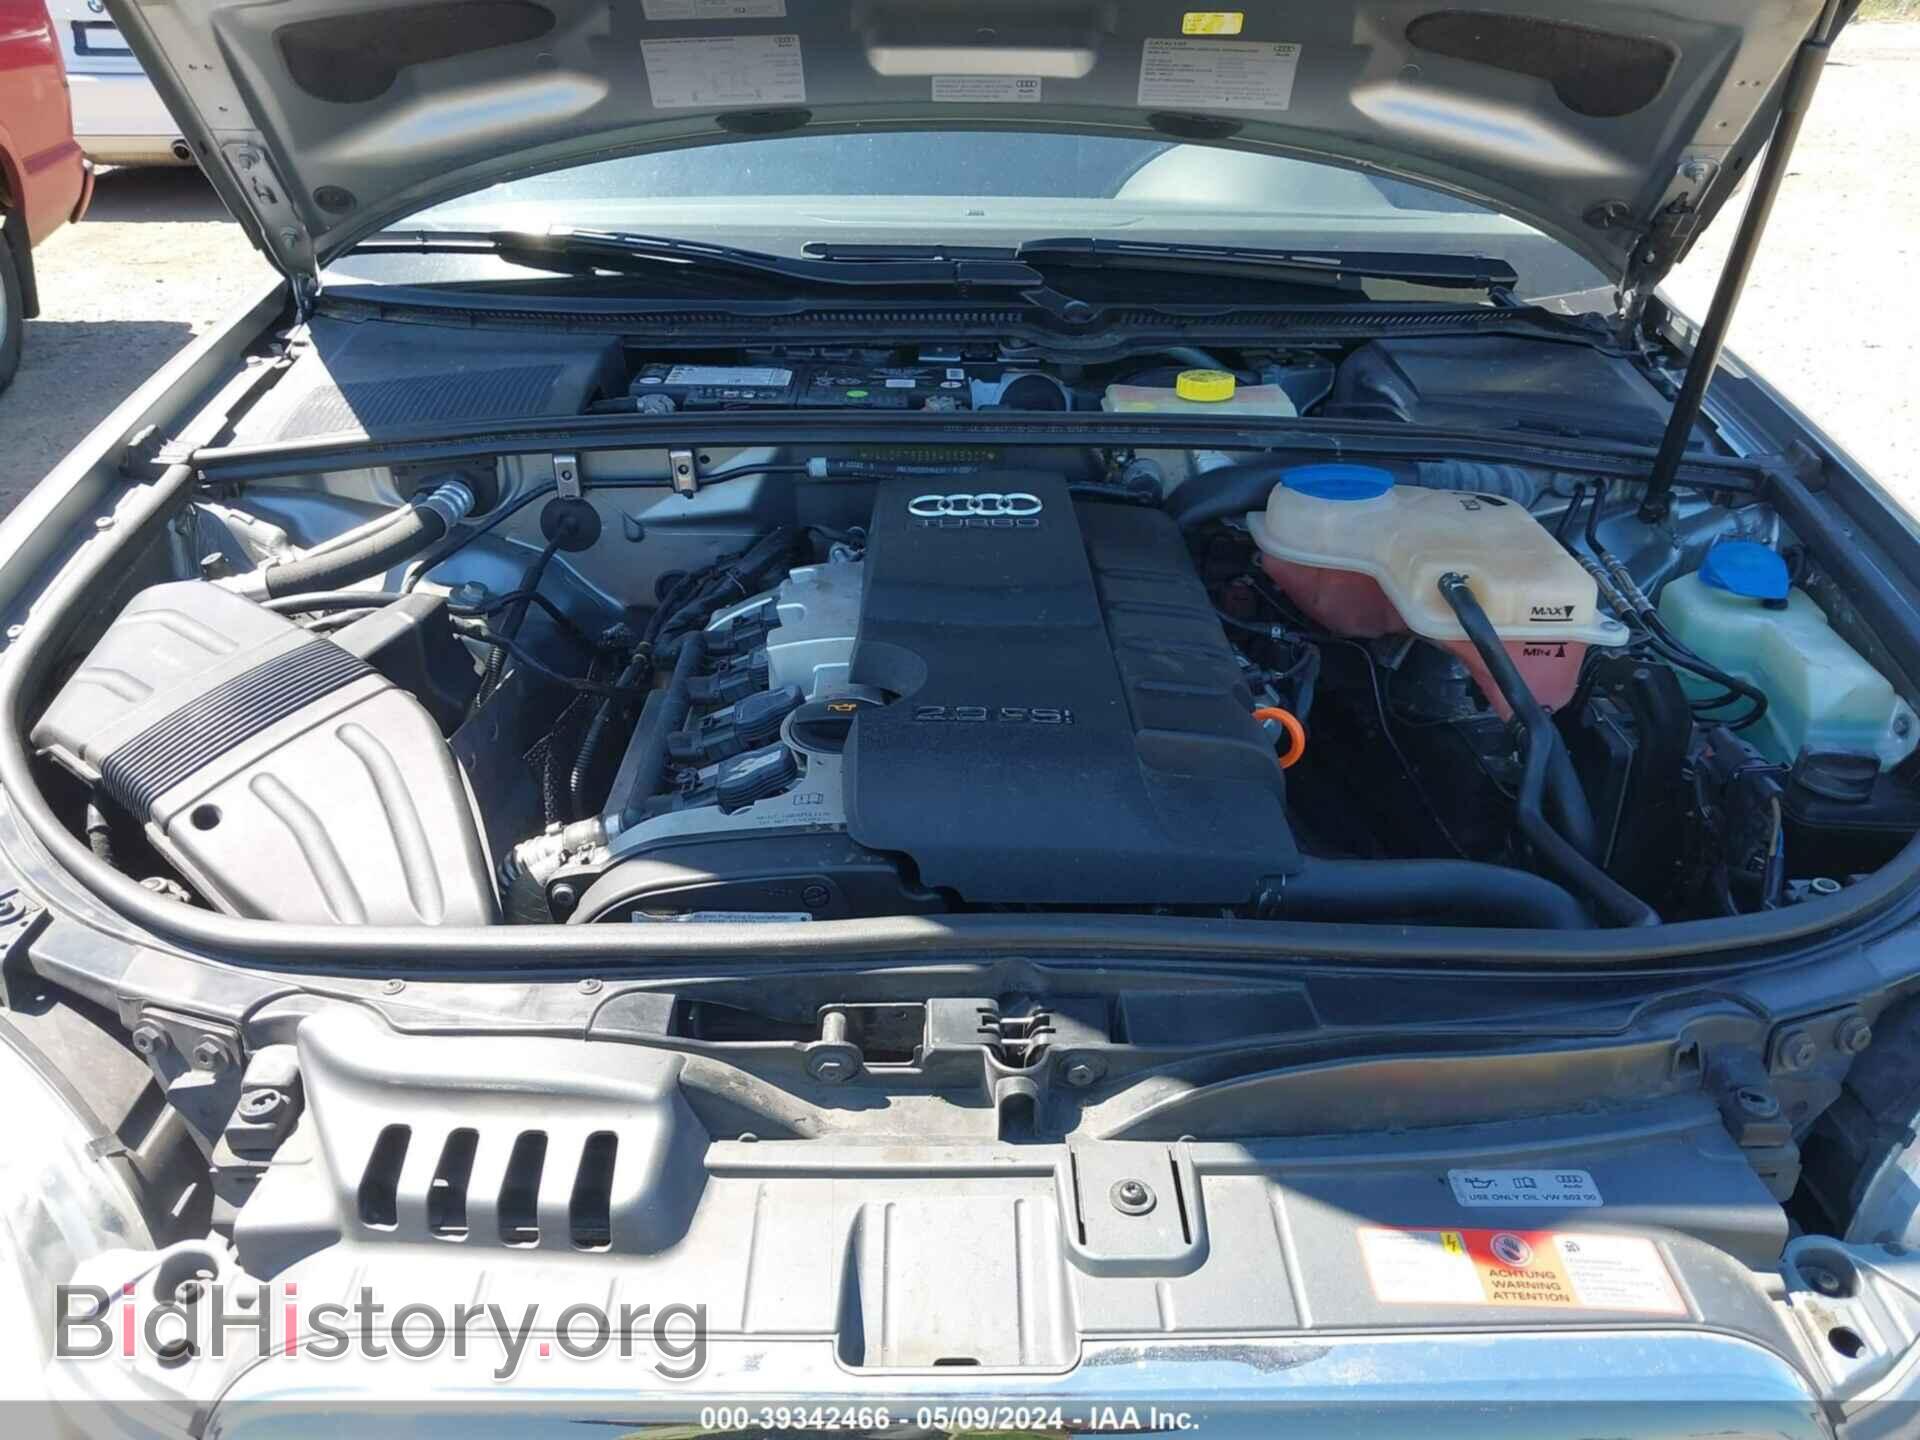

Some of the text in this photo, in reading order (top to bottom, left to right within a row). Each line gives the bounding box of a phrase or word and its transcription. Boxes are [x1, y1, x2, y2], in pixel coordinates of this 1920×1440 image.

[915, 518, 1040, 528] TURBO
[1531, 606, 1562, 616] MAX
[1469, 1193, 1489, 1201] USE
[1492, 1193, 1519, 1201] ONLY
[1523, 1193, 1539, 1201] OIL
[1543, 1193, 1560, 1201] VW
[1489, 1269, 1556, 1279] ACHTUNG
[1491, 1280, 1561, 1290] WARNING
[1493, 1291, 1570, 1302] ATTENTION
